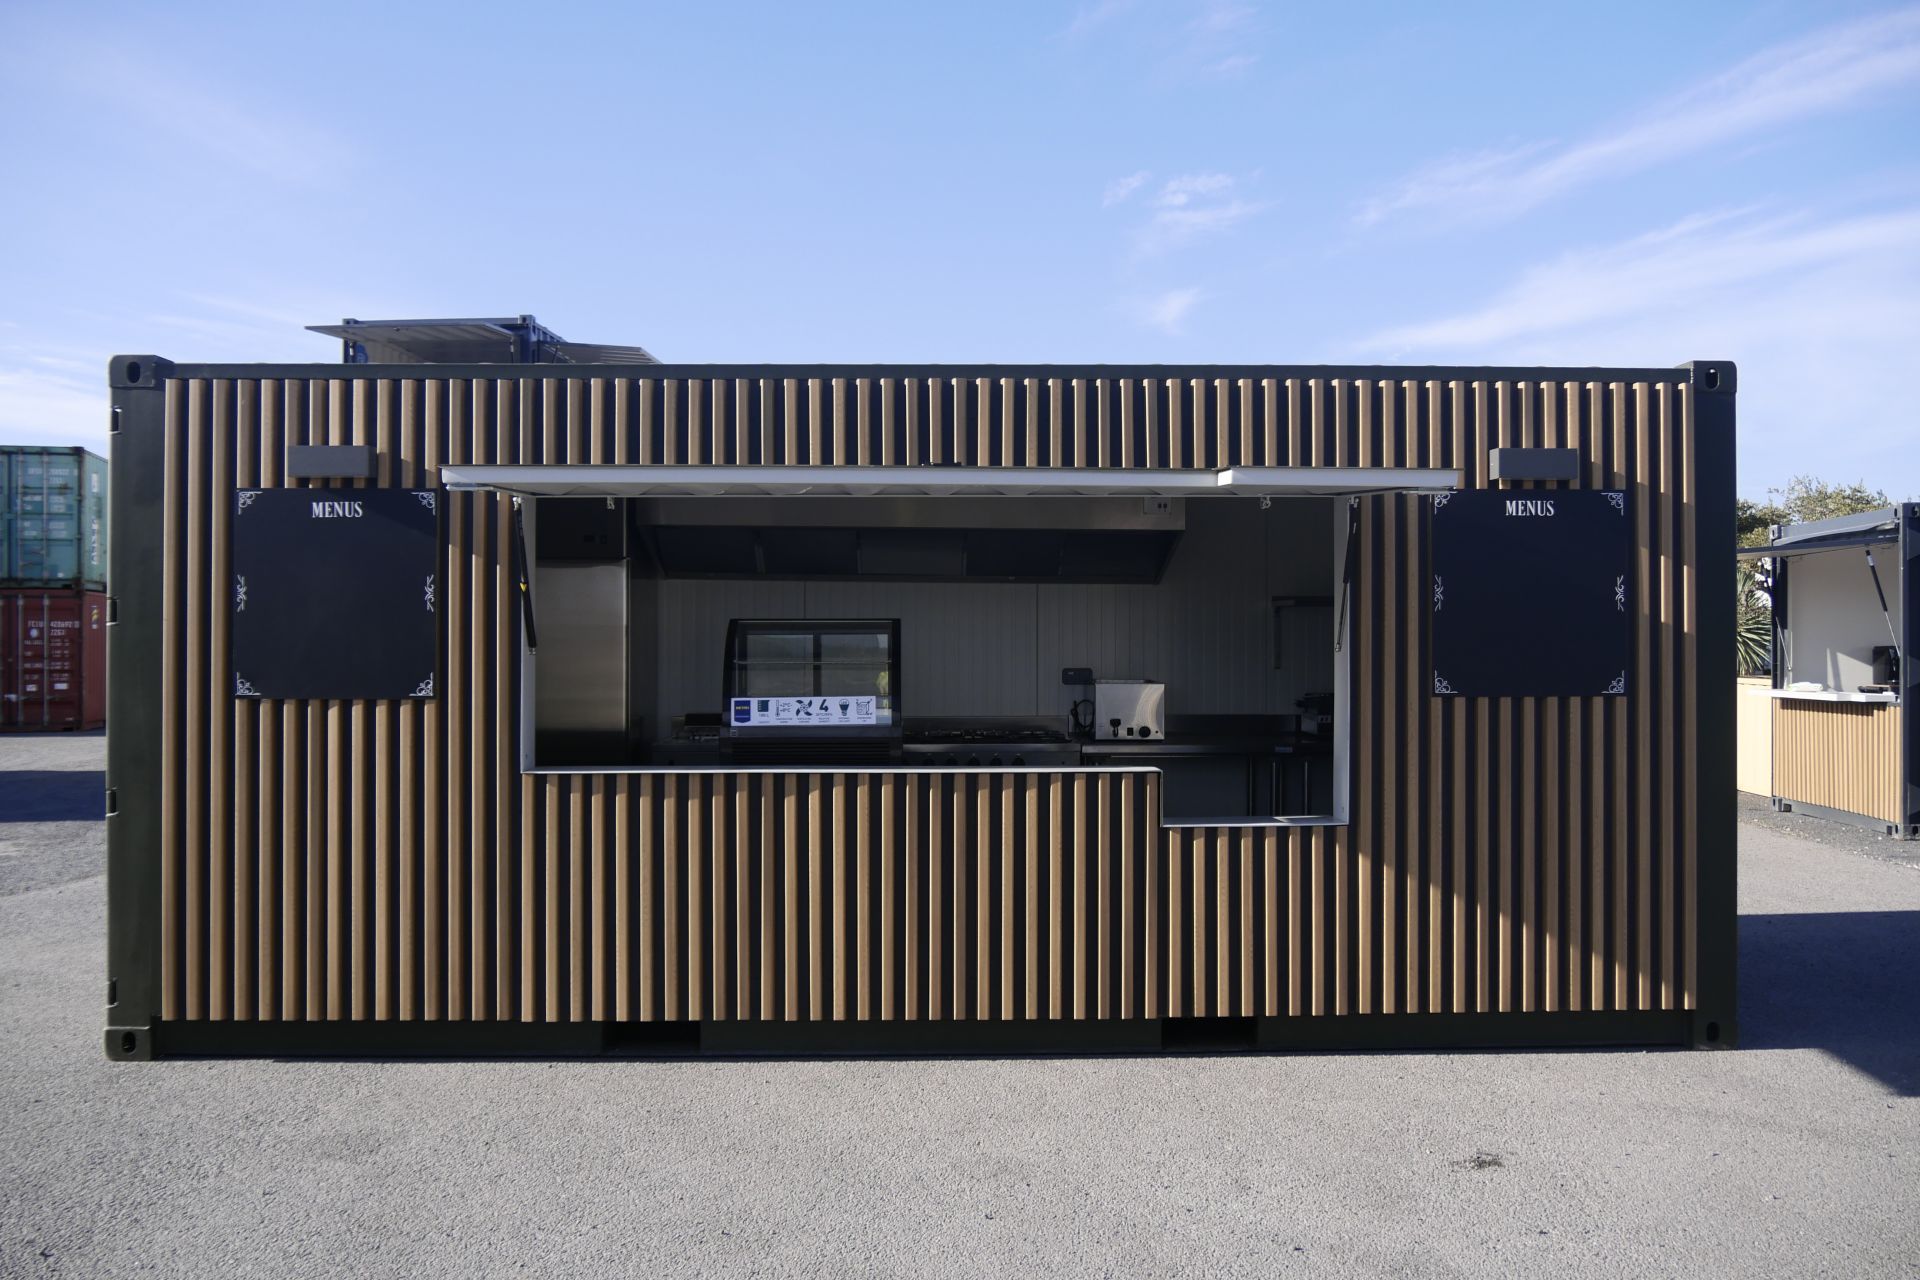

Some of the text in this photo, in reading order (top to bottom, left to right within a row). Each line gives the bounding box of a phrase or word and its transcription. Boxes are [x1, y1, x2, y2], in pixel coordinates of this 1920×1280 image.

[312, 501, 363, 518] MENUS
[1505, 500, 1555, 517] MENUS
[819, 699, 829, 712] 4
